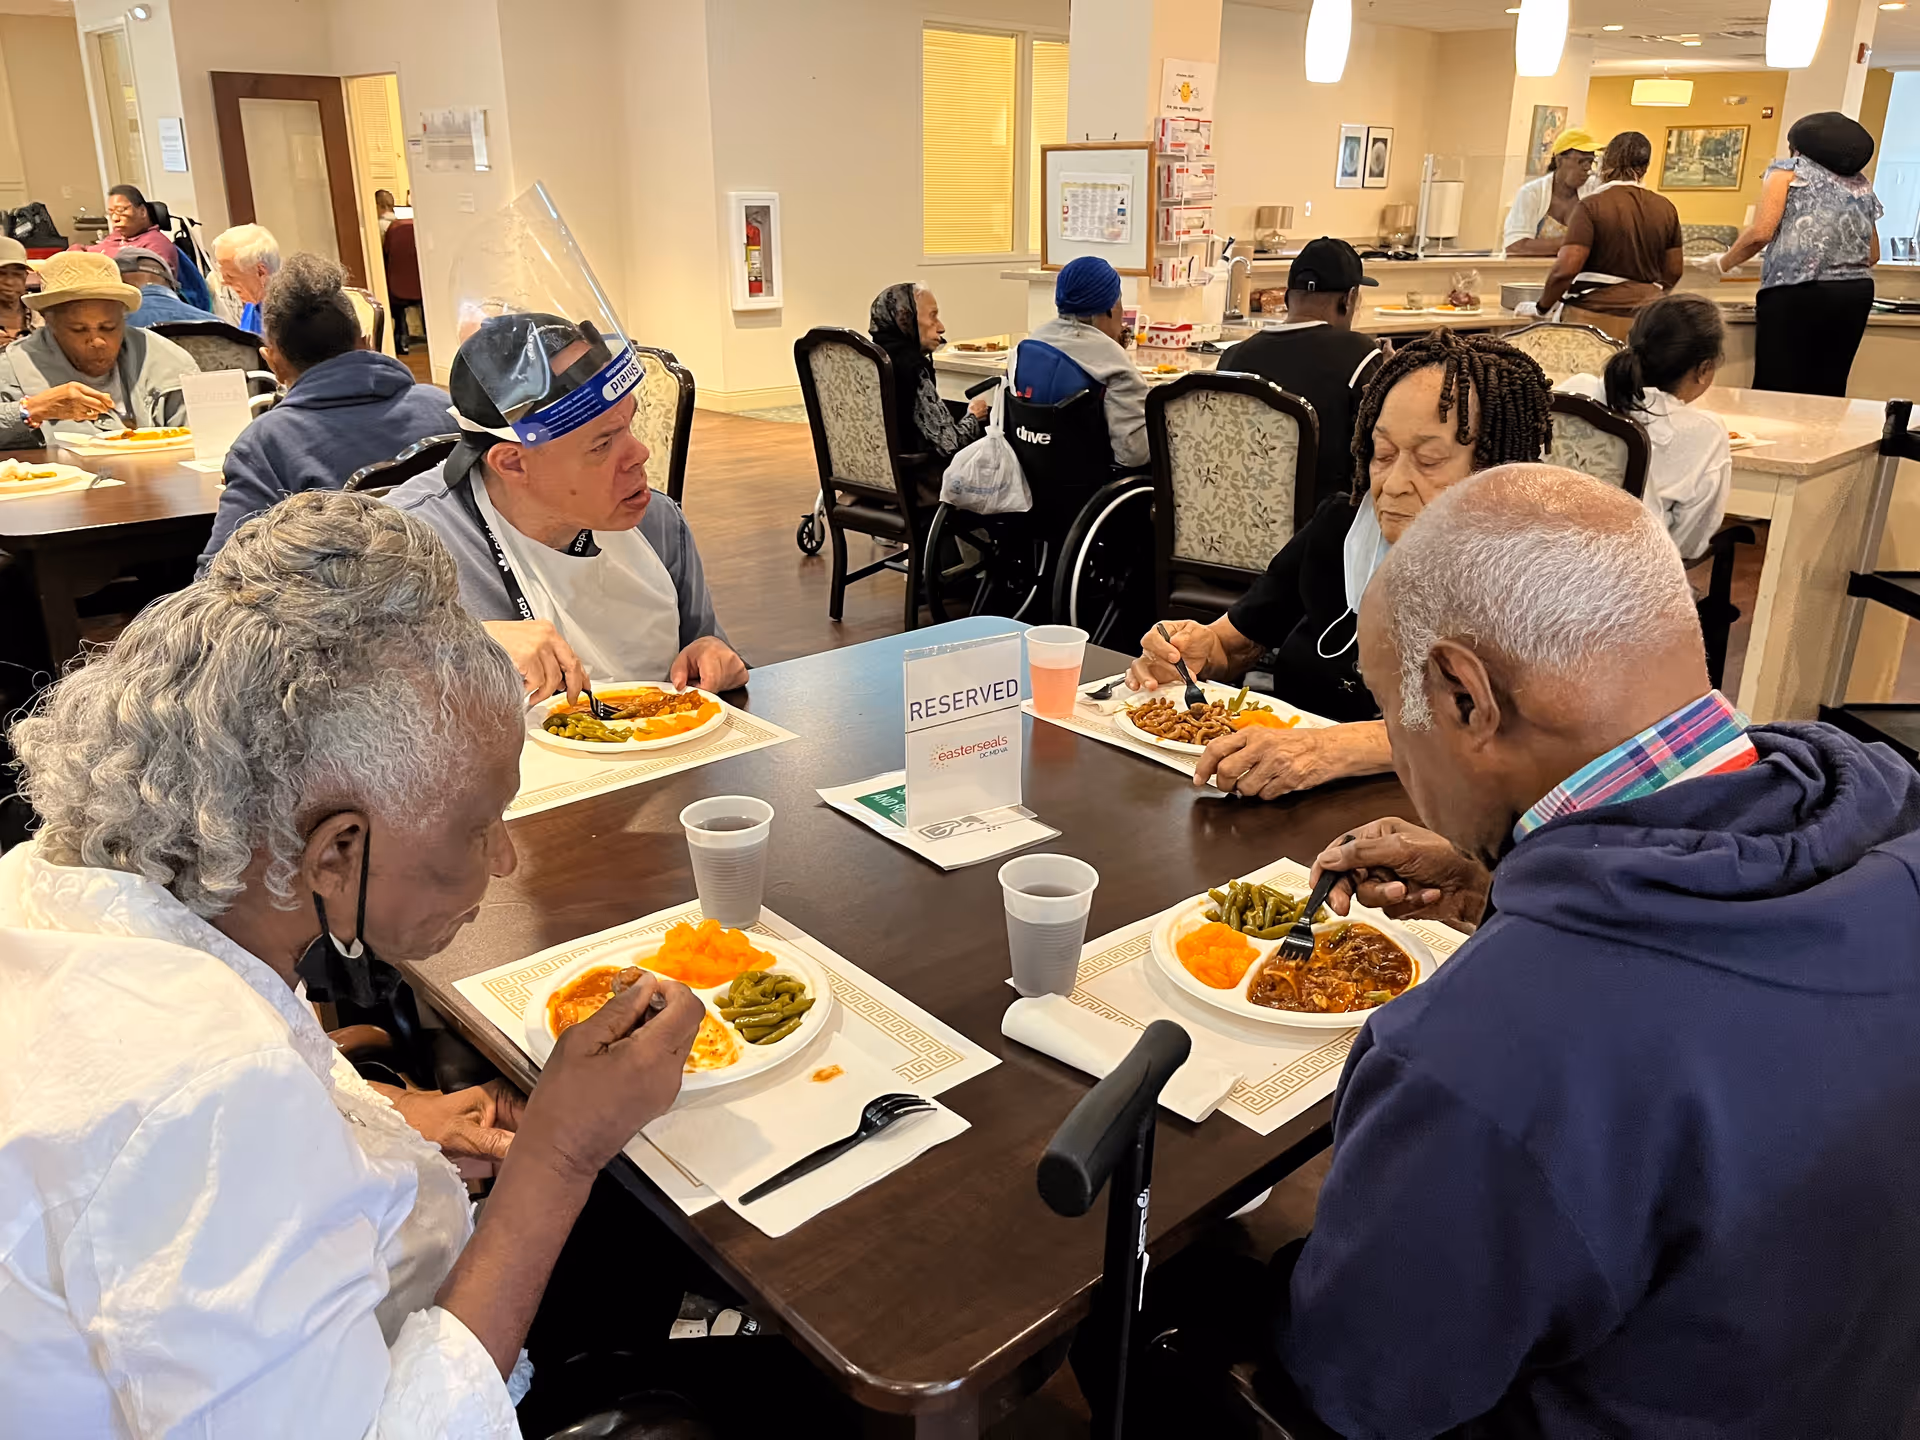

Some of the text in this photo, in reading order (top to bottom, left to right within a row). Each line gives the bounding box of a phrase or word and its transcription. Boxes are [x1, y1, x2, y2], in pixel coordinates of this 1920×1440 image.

[610, 362, 640, 394] Shield
[1016, 425, 1052, 445] drive
[910, 679, 1018, 721] RESERVED
[938, 735, 1009, 761] easterseals
[979, 751, 989, 760] DC
[989, 748, 1000, 756] MD
